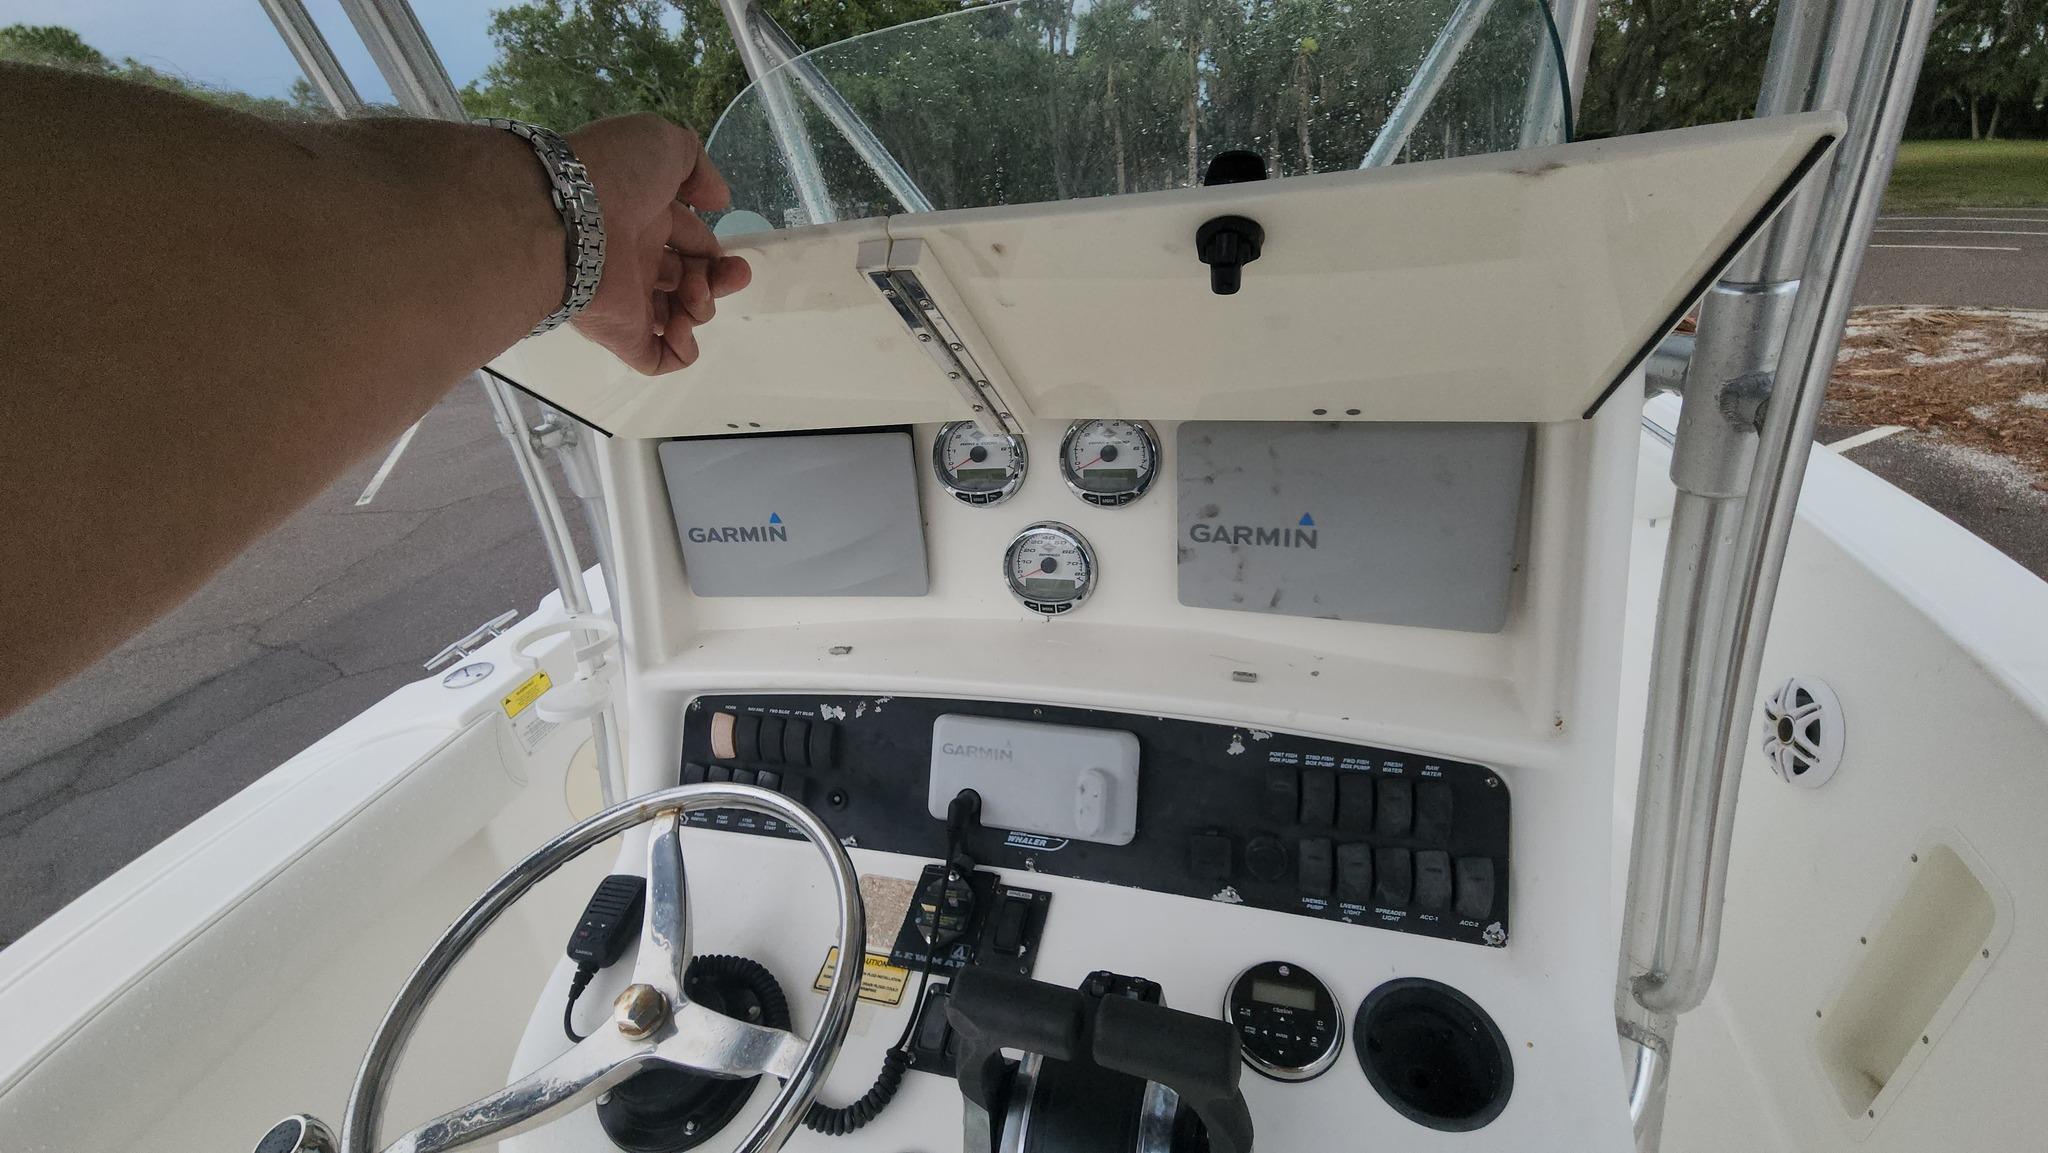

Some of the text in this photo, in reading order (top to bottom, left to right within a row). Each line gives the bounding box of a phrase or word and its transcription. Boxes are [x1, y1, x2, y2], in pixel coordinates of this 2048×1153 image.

[688, 526, 788, 543] GARMIN
[1190, 524, 1318, 550] GARMIN
[942, 742, 1013, 762] GARMIN
[1008, 835, 1046, 847] WHALER
[1302, 897, 1328, 906] LIVEWELL
[1340, 902, 1366, 911] LIVEWELL
[1375, 908, 1406, 917] SPREADER
